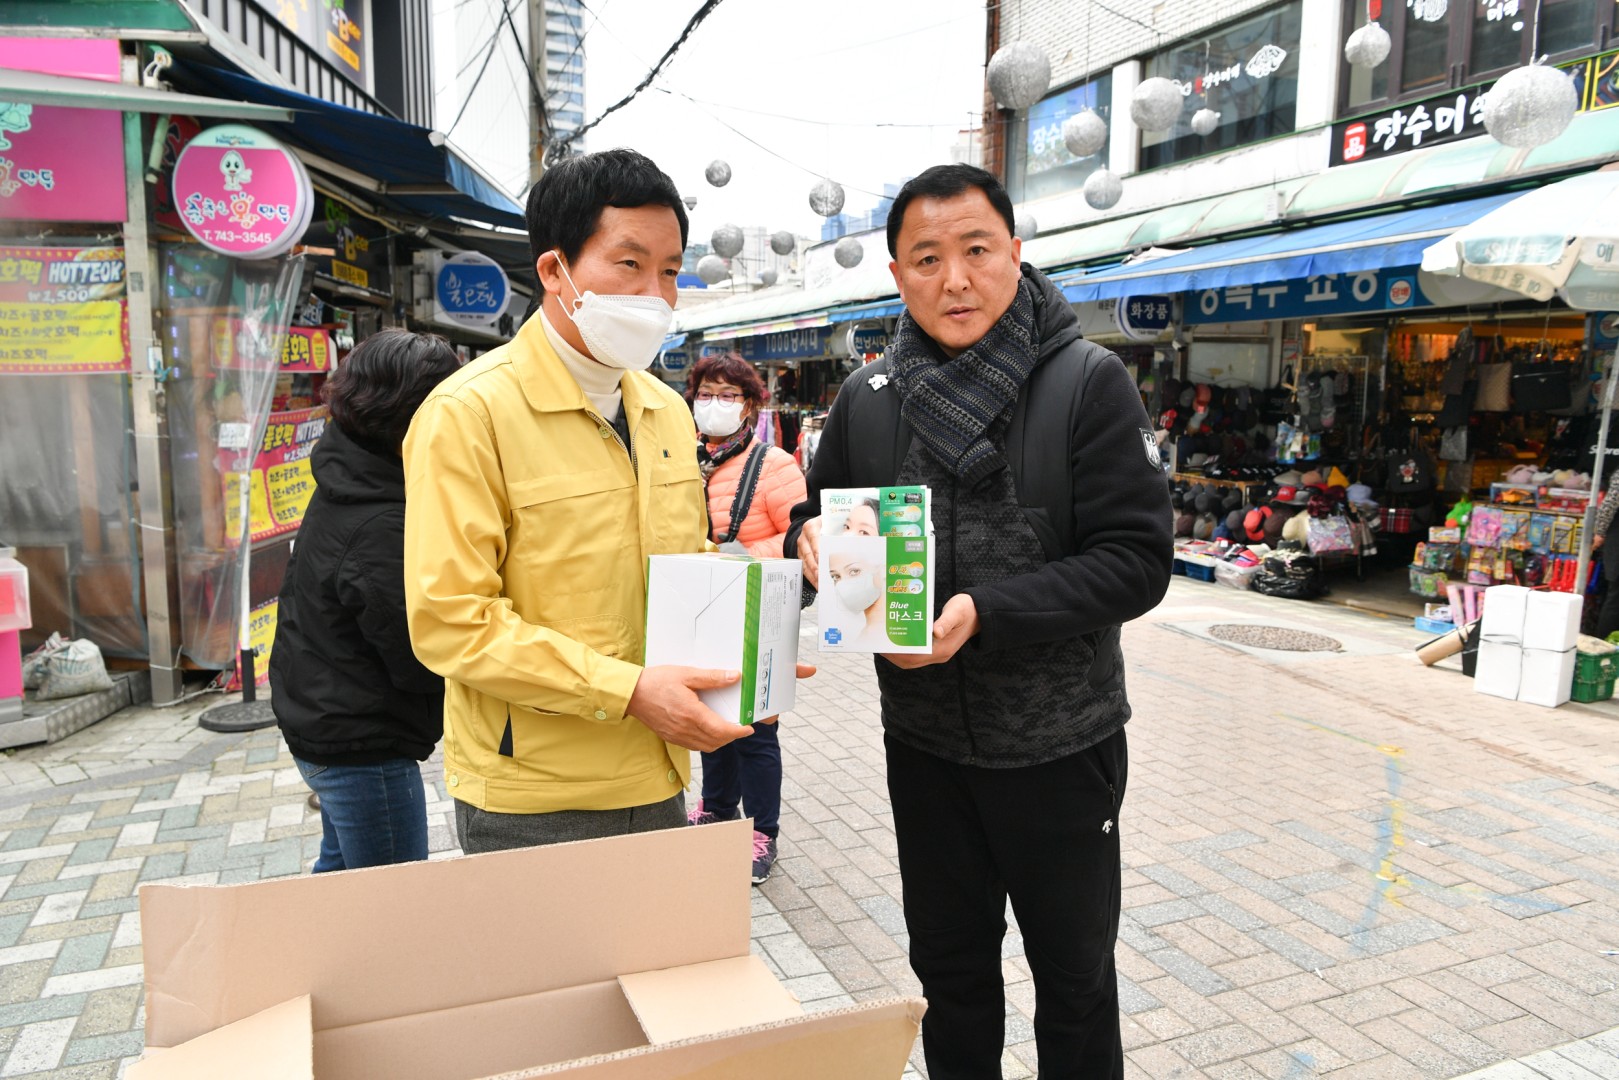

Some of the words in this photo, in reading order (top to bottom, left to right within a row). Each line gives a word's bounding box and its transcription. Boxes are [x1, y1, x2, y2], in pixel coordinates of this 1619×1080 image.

[214, 230, 272, 243] 743-3545
[48, 260, 124, 284] HOTTEOK
[1130, 301, 1168, 320] 화장품
[889, 601, 909, 609] Blue
[889, 610, 924, 622] 마스크
